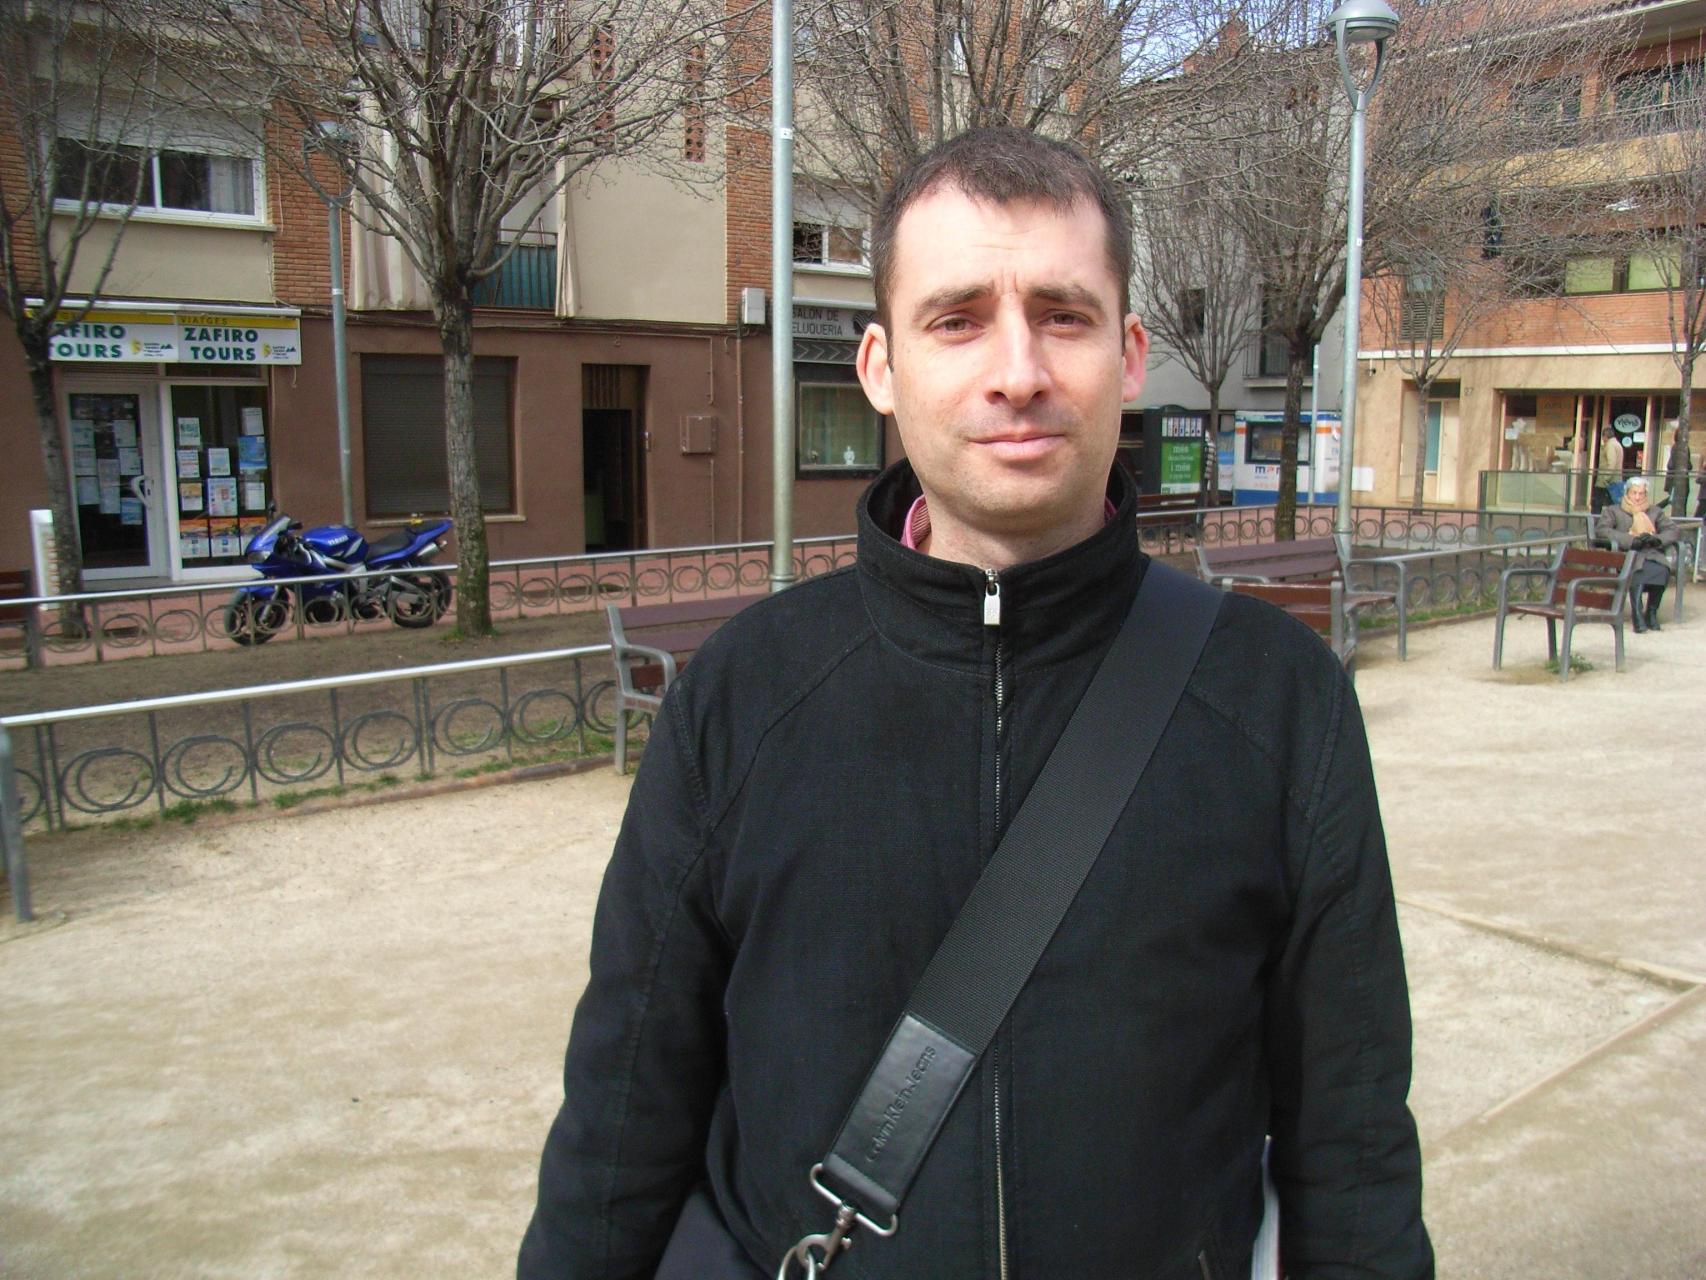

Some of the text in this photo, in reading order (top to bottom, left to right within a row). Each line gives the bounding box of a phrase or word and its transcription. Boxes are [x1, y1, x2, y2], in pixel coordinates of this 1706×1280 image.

[827, 309, 839, 322] DE
[56, 323, 126, 339] AFIRO
[184, 327, 258, 343] ZAFIRO
[793, 322, 843, 336] ELUQUERIA
[49, 343, 122, 359] OURS
[190, 346, 256, 361] TOURS
[905, 1045, 937, 1091] Jeans
